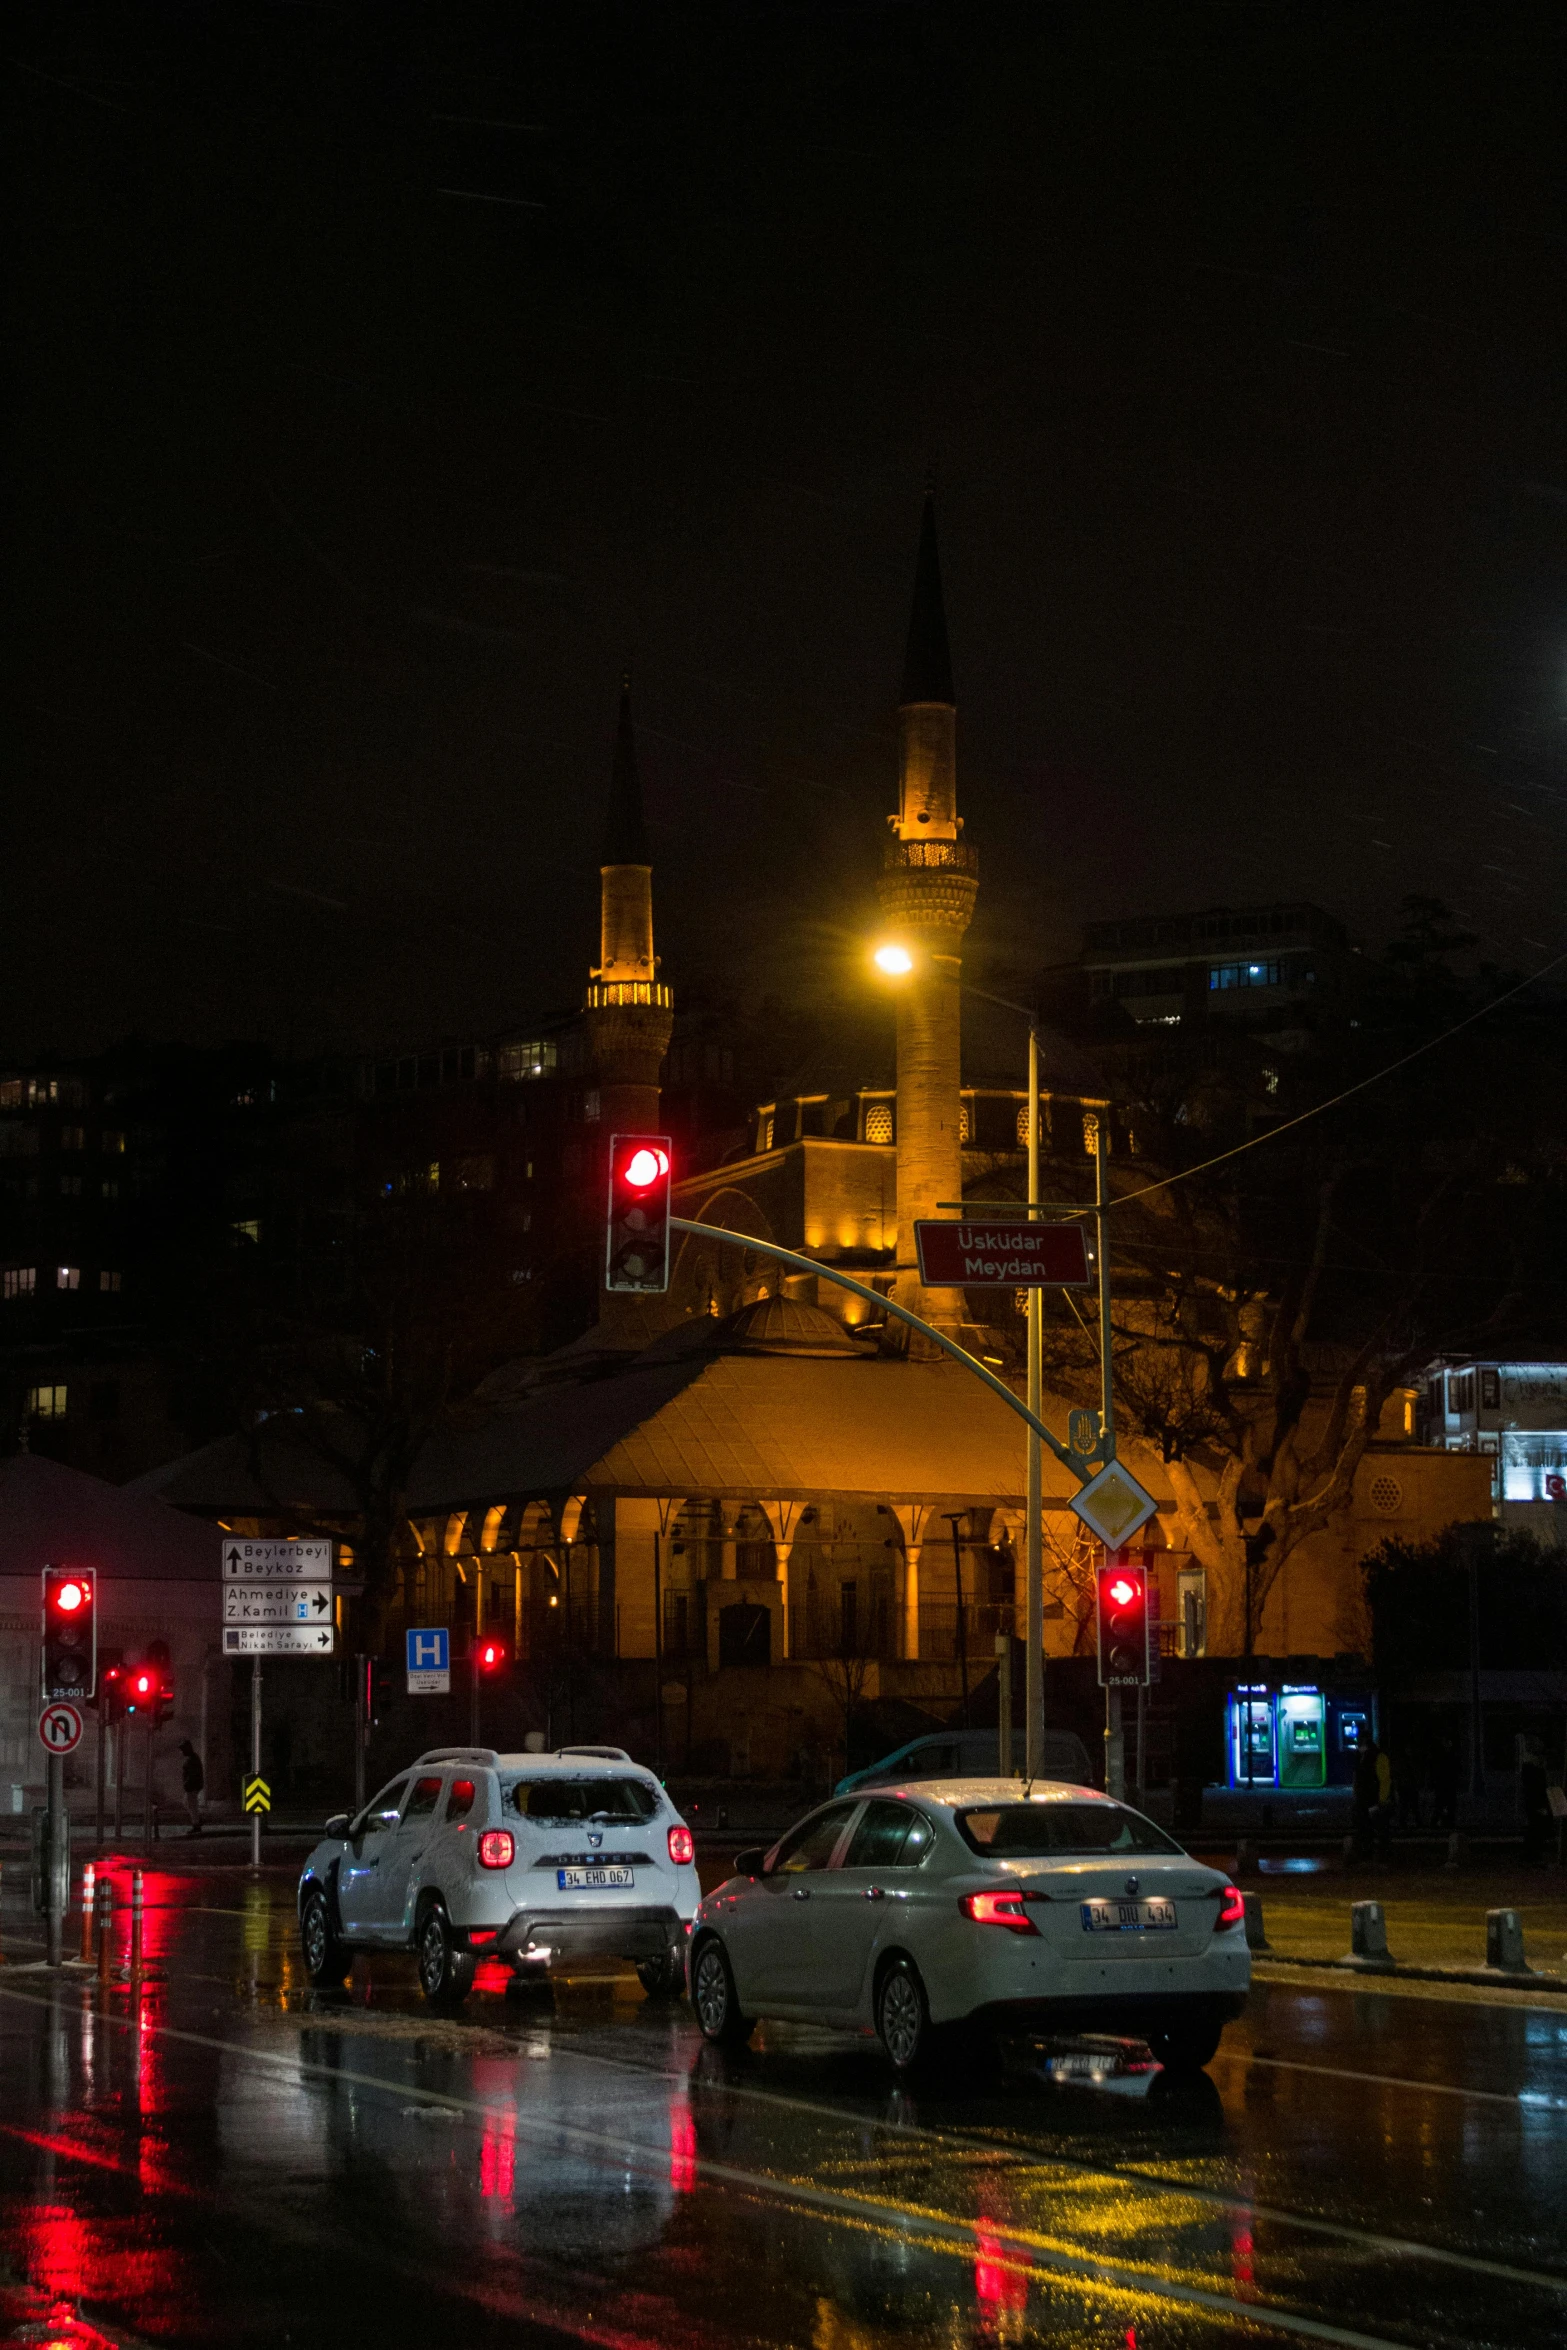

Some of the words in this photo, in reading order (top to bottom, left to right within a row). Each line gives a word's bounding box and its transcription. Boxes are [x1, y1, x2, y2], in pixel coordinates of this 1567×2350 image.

[958, 1228, 1044, 1250] Üsküdar
[964, 1257, 1046, 1280] Meydan
[244, 1545, 328, 1558] Beylerbeyi
[244, 1562, 303, 1576] Beykoz
[228, 1589, 308, 1602] Ahmediye
[241, 1631, 292, 1639] Belediye
[241, 1641, 274, 1649] Nikah
[415, 1634, 441, 1666] H
[1109, 1676, 1139, 1685] 25-001
[53, 1688, 84, 1697] 25-001
[558, 1854, 633, 1863] DUSTER
[566, 1872, 580, 1884] 34
[585, 1870, 606, 1884] EHD
[609, 1870, 629, 1883] 067
[1092, 1907, 1109, 1923] 34
[1148, 1905, 1172, 1922] 434
